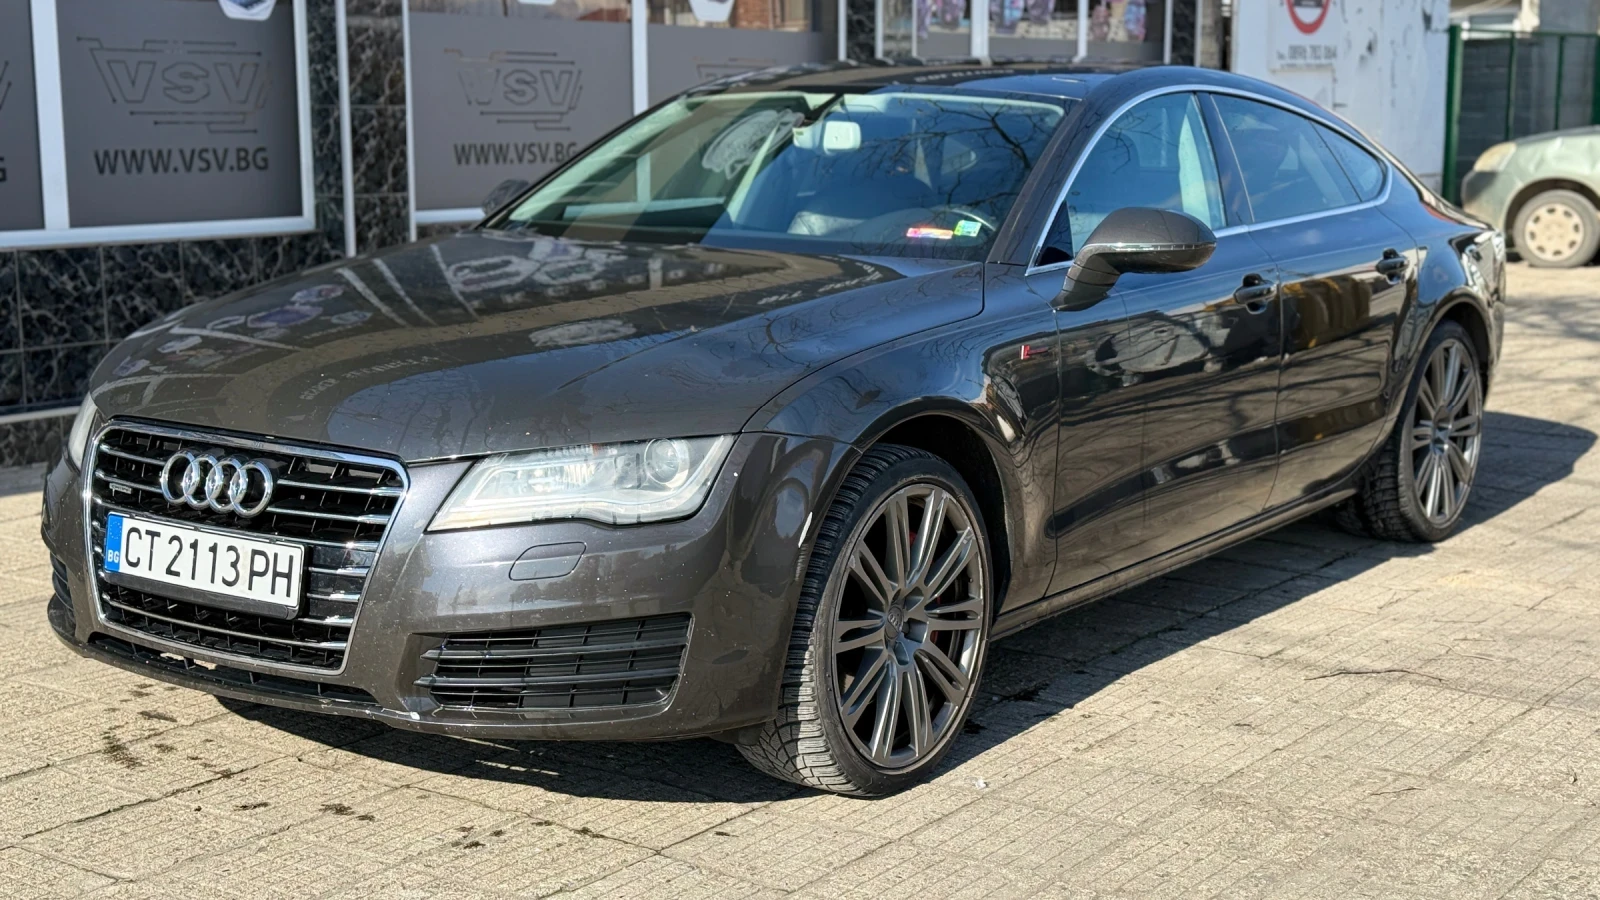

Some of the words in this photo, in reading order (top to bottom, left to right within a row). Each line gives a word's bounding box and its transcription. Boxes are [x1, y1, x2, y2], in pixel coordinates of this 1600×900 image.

[106, 59, 260, 105] VSV
[457, 68, 573, 106] VSV
[94, 147, 269, 175] WWW.VSV.BG
[454, 142, 577, 165] WWW.VSV.BG
[107, 549, 120, 564] BG
[125, 526, 161, 571] CT
[165, 534, 241, 587] 2113
[248, 548, 294, 598] PH
